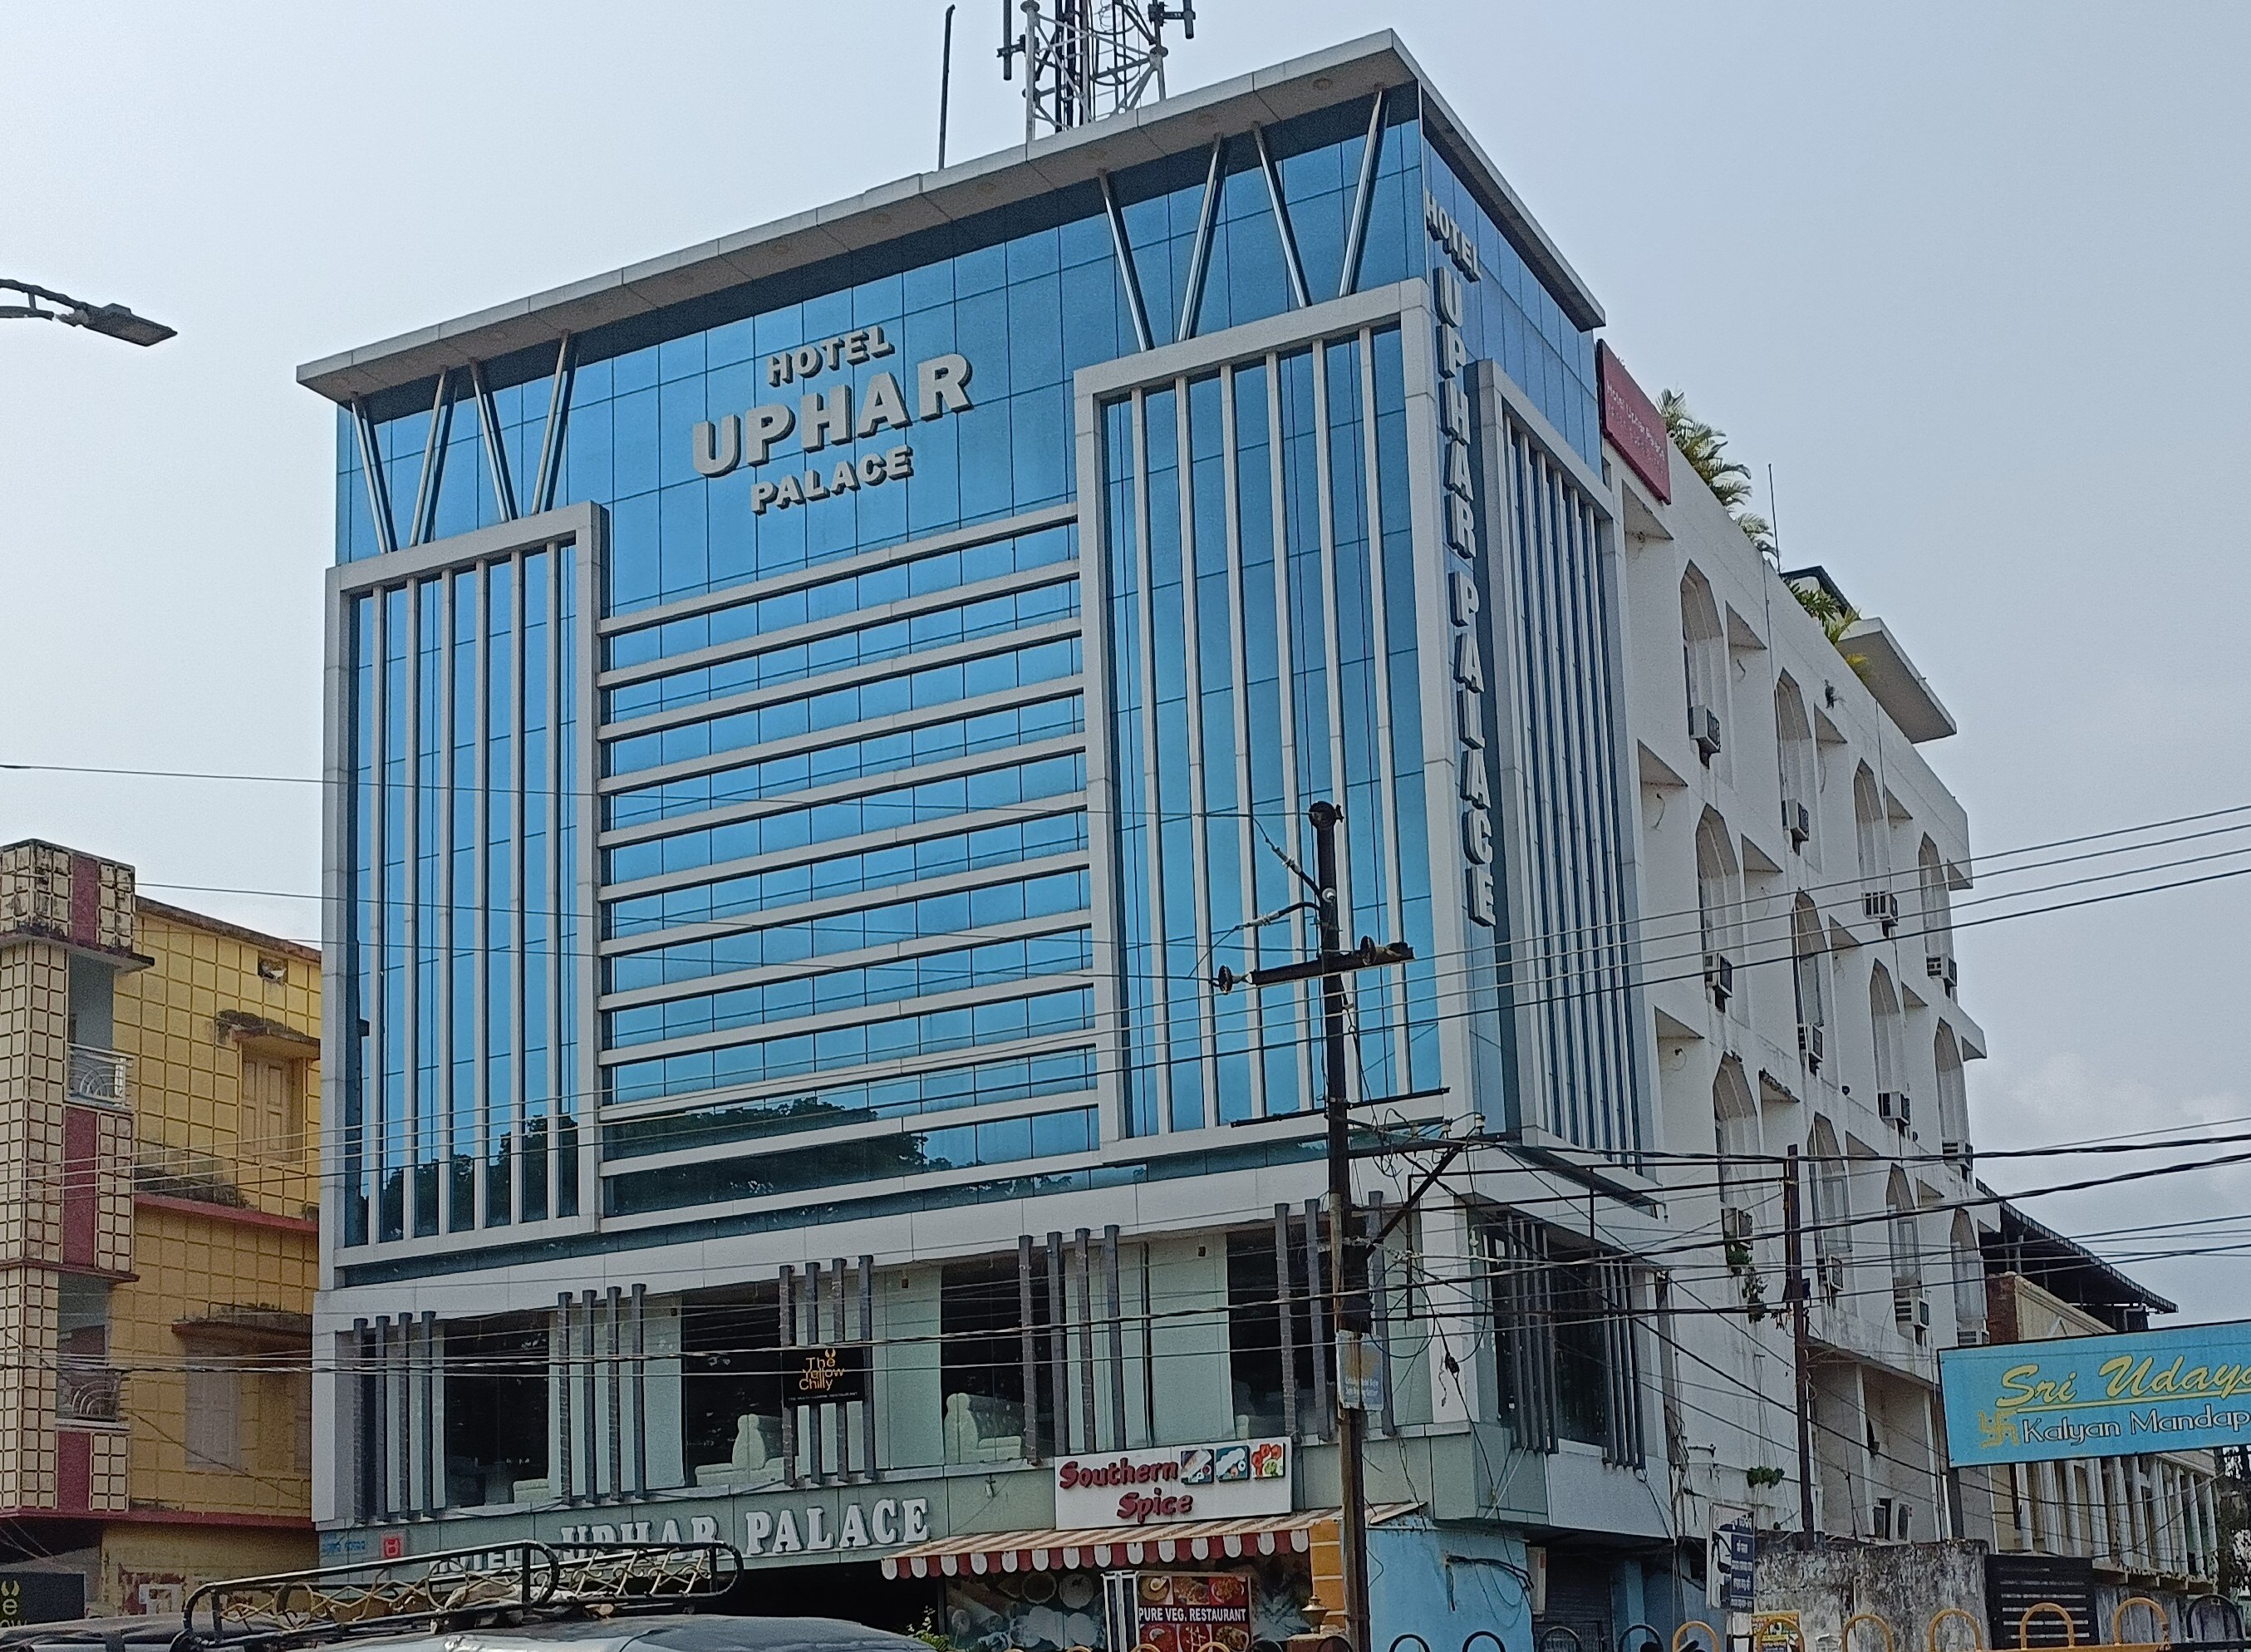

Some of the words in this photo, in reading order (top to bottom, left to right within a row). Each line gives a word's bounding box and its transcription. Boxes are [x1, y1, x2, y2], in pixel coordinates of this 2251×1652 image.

[1424, 187, 1482, 283] HOTEL
[766, 325, 895, 387] HOTEL
[692, 352, 975, 478] UPHAR
[1433, 266, 1477, 559] UPHAR
[750, 444, 915, 516] PALACE
[1448, 570, 1497, 927] PALACE
[805, 1356, 836, 1370] The
[1996, 1364, 2077, 1408] Sri
[2022, 1416, 2121, 1446] Kalyan
[1059, 1458, 1179, 1490] Southern
[745, 1497, 930, 1555] PALACE
[1116, 1487, 1194, 1525] Spice
[1138, 1607, 1164, 1623] PURE
[1165, 1608, 1187, 1623] VEG.
[1189, 1607, 1246, 1623] RESTAURANT
